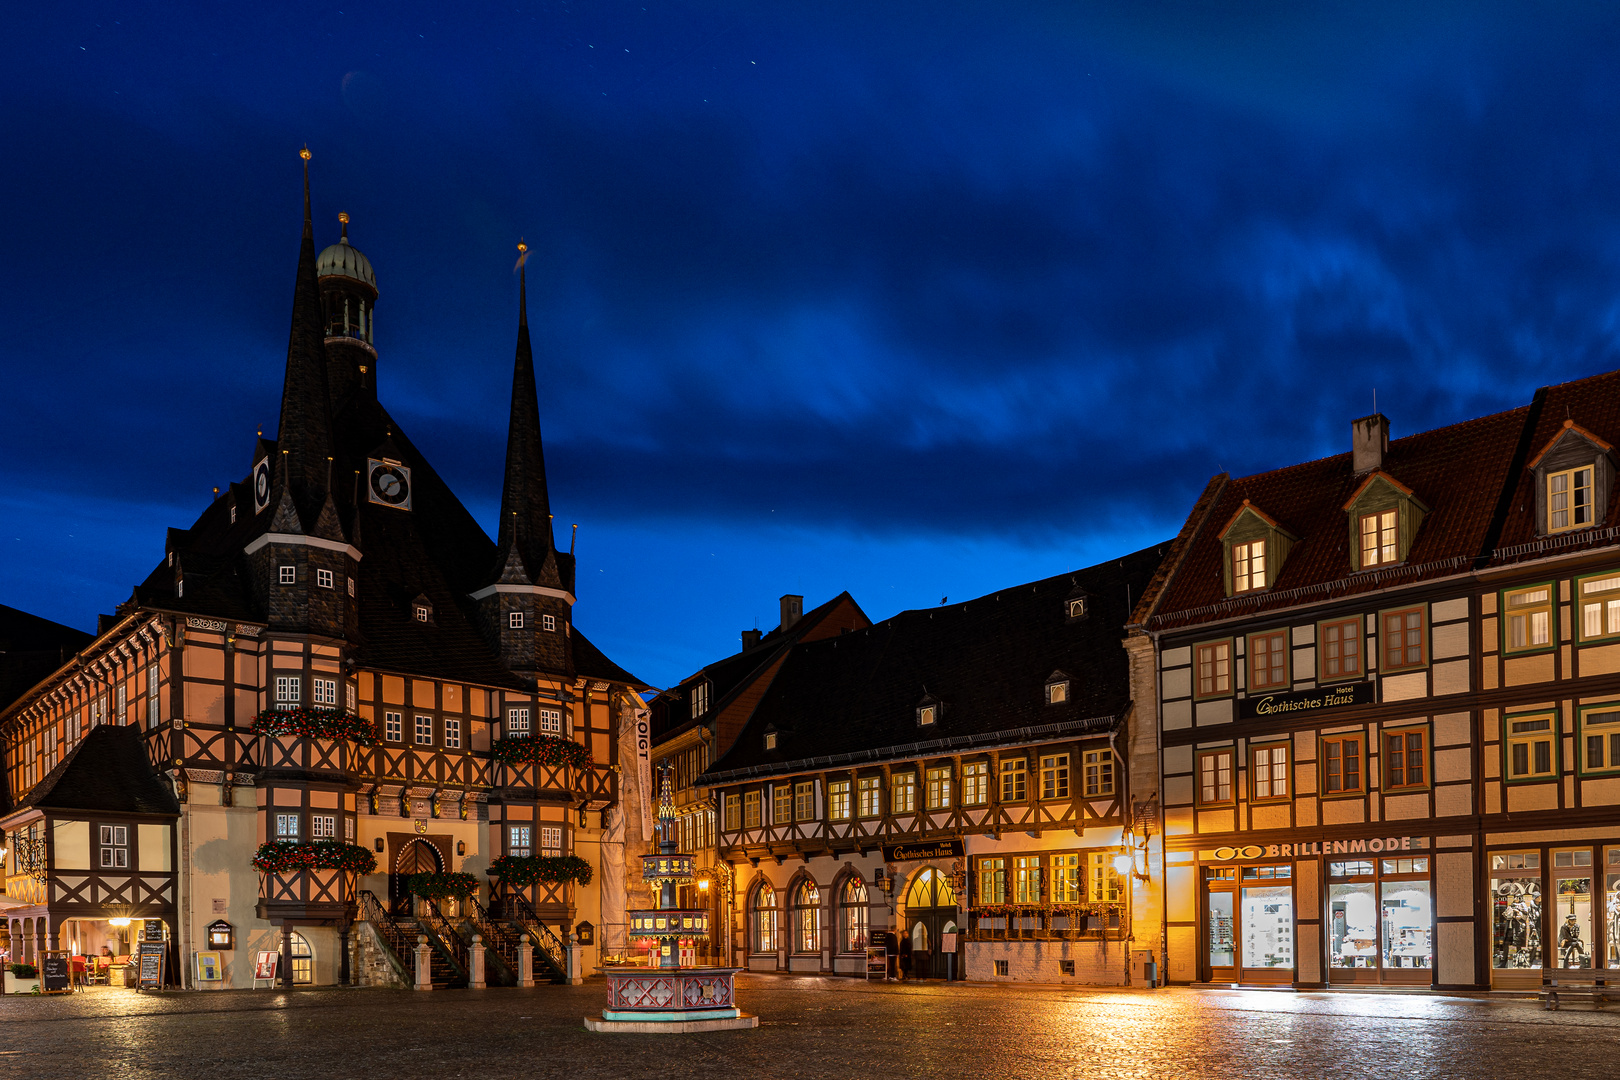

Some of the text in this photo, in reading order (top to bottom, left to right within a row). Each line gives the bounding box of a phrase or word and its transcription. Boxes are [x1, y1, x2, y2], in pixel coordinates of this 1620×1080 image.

[1336, 685, 1354, 694] Hotel
[1256, 694, 1354, 715] Gothisches Haus
[893, 846, 953, 859] Gothisches Haus
[1270, 836, 1411, 857] BRILLENMODE
